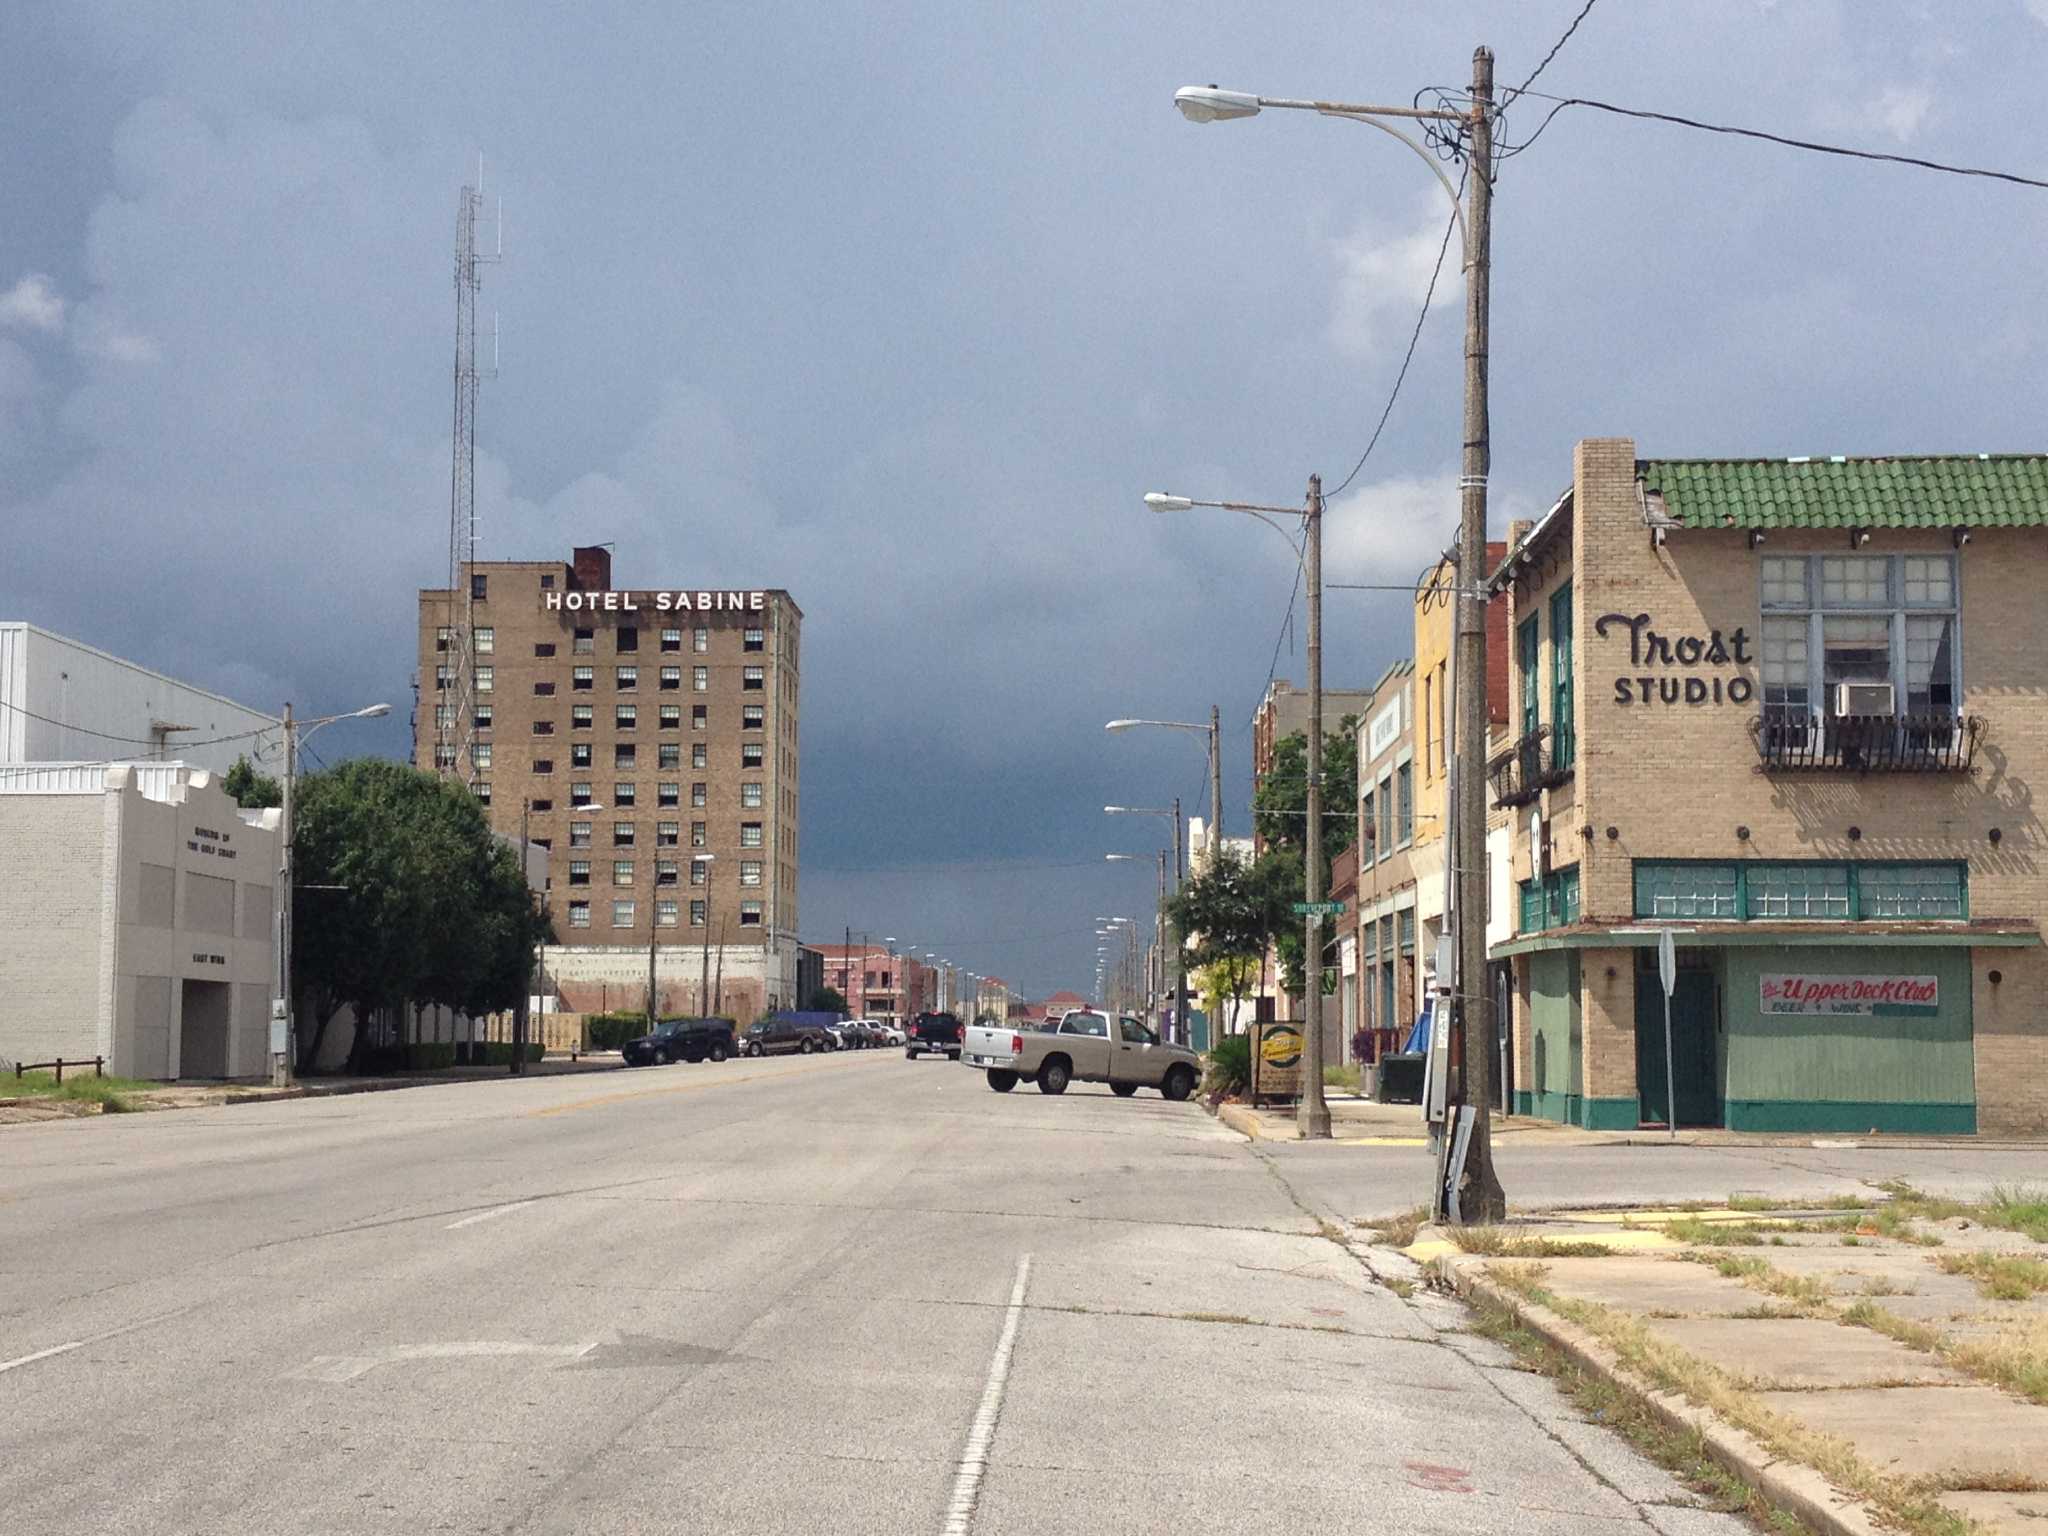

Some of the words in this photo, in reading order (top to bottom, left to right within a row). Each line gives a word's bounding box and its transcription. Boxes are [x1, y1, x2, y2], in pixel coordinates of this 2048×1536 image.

[546, 592, 638, 610] HOTEL
[656, 592, 765, 610] SABINE
[1595, 613, 1753, 664] Trost
[1614, 677, 1752, 703] STUDIO
[1783, 978, 1849, 1003] Upper
[1851, 980, 1894, 1002] Deck
[1895, 980, 1936, 1001] Club
